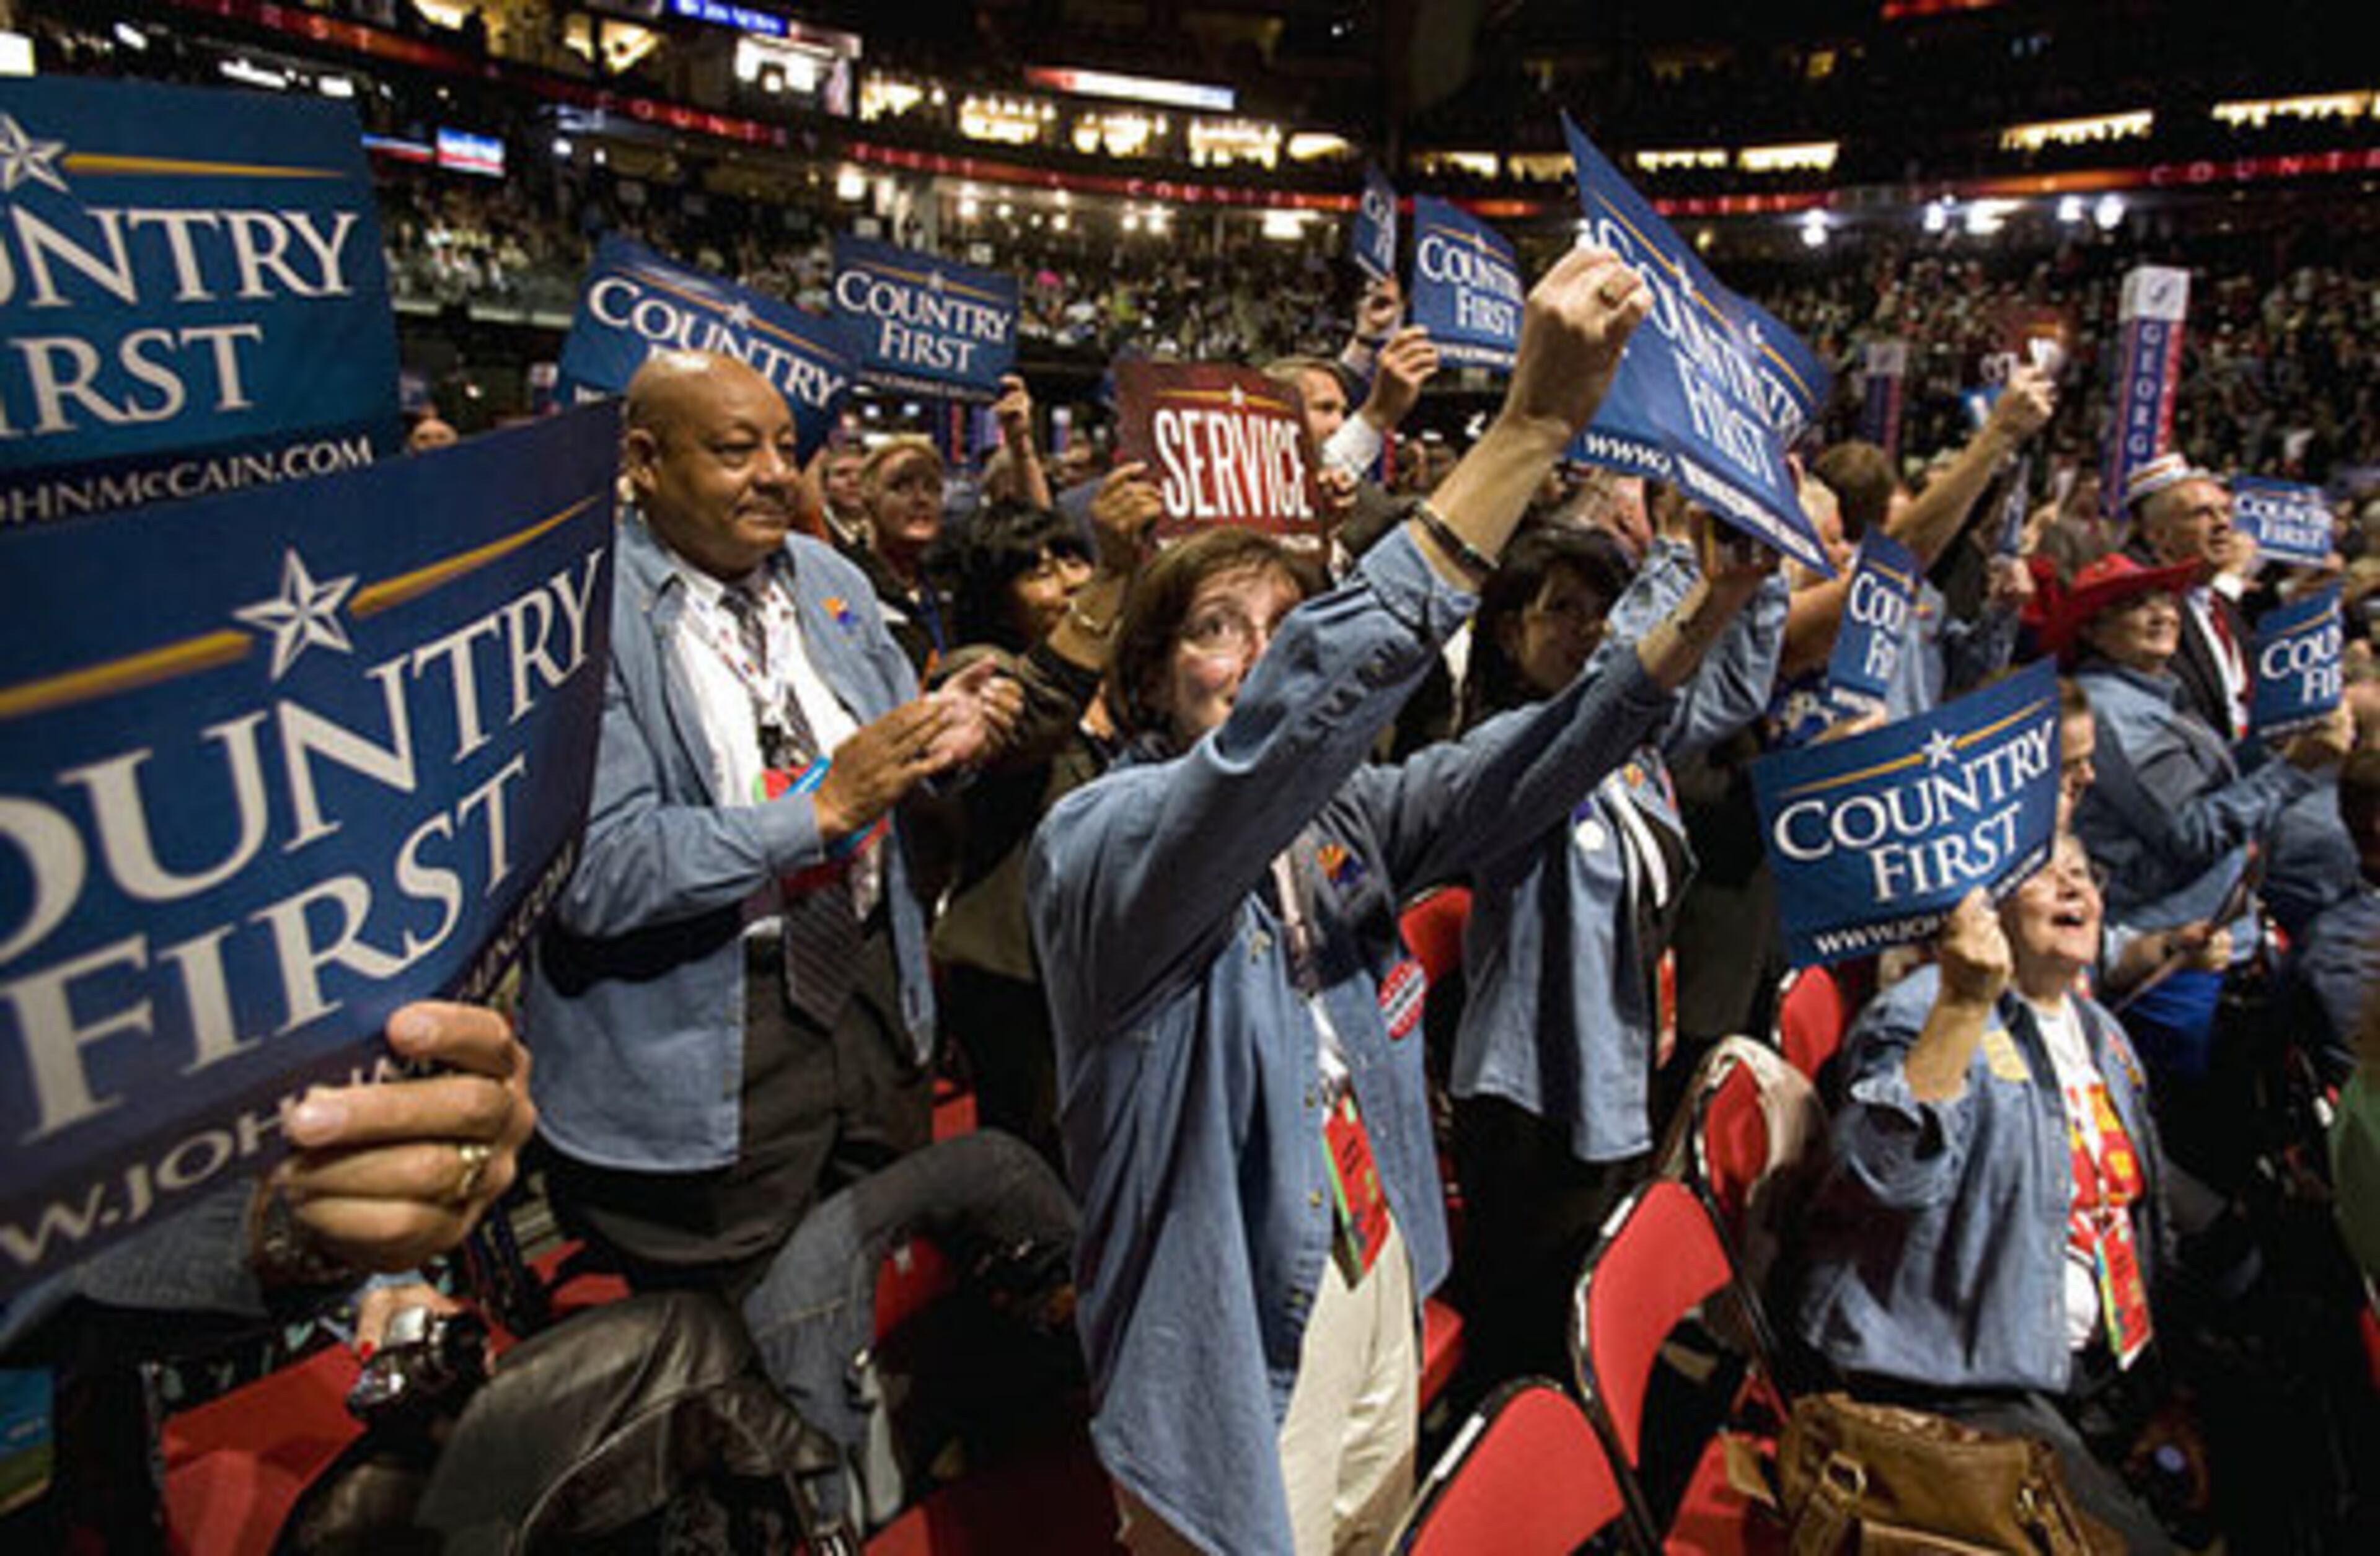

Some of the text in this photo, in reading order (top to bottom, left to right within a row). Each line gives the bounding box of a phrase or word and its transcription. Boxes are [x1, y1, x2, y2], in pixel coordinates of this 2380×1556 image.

[0, 204, 359, 309] NTRY
[836, 270, 1010, 343] COUNTRY
[588, 276, 845, 409] COUNTRY
[879, 319, 977, 374] FIRST
[2127, 322, 2163, 471] GEORG
[1154, 408, 1314, 521] SERVICE
[1773, 718, 2055, 861] COUNTRY
[1866, 801, 2024, 903] FIRST
[0, 754, 526, 1146] FIRST
